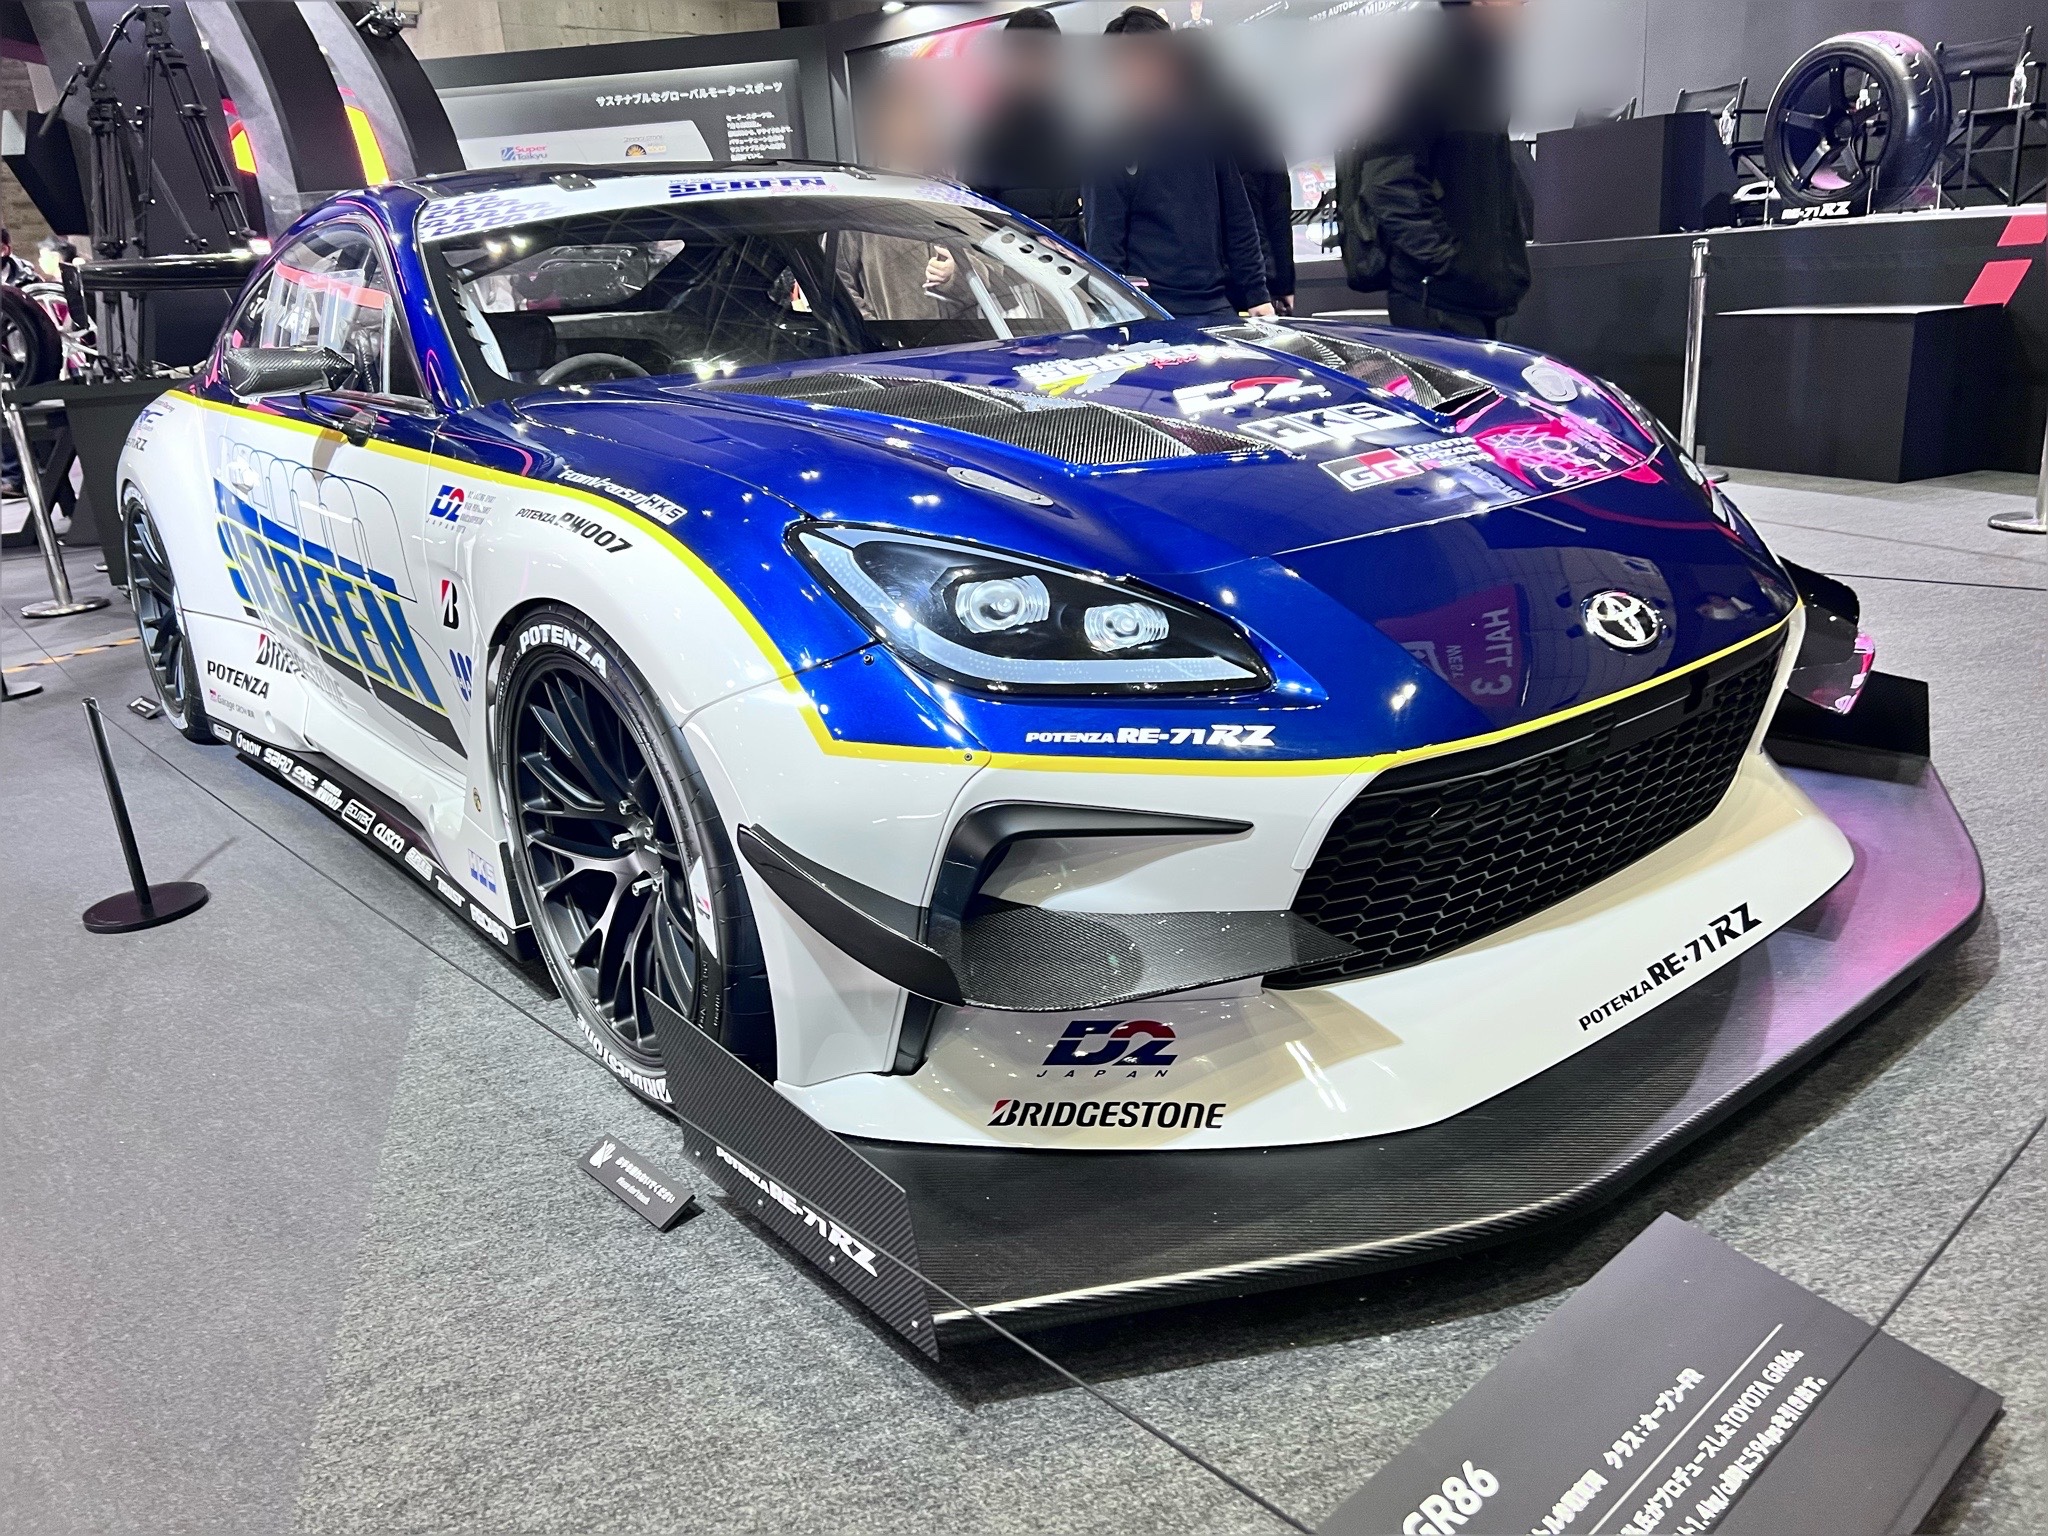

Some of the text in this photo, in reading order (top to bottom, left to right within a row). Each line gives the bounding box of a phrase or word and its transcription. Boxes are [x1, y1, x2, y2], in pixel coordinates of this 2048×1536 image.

[595, 81, 783, 107] サステナブルなグローバルモータースポーツ
[515, 145, 547, 154] Super
[516, 152, 548, 162] Taikyu
[1395, 436, 1477, 454] TOYOTA
[1409, 444, 1483, 462] GAZOO
[1336, 459, 1420, 489] GR
[1419, 452, 1496, 471] Racing
[429, 485, 465, 523] D2
[516, 508, 557, 526] POTENZA
[642, 494, 687, 524] HKS
[216, 516, 448, 715] SCREEN
[519, 623, 608, 679] POTENZA
[207, 660, 270, 699] POTENZA
[1025, 724, 1276, 747] POTENZA RE-71RZ
[373, 823, 405, 853] CUSCO
[1578, 902, 1763, 1032] POTENZA RE-71RZ
[1042, 1020, 1178, 1066] D2
[1036, 1069, 1169, 1078] JAPAN
[987, 1099, 1227, 1129] BRIDGESTONE
[716, 1145, 878, 1278] POTENZA RE-71RZ
[1402, 1459, 1500, 1536] GR86
